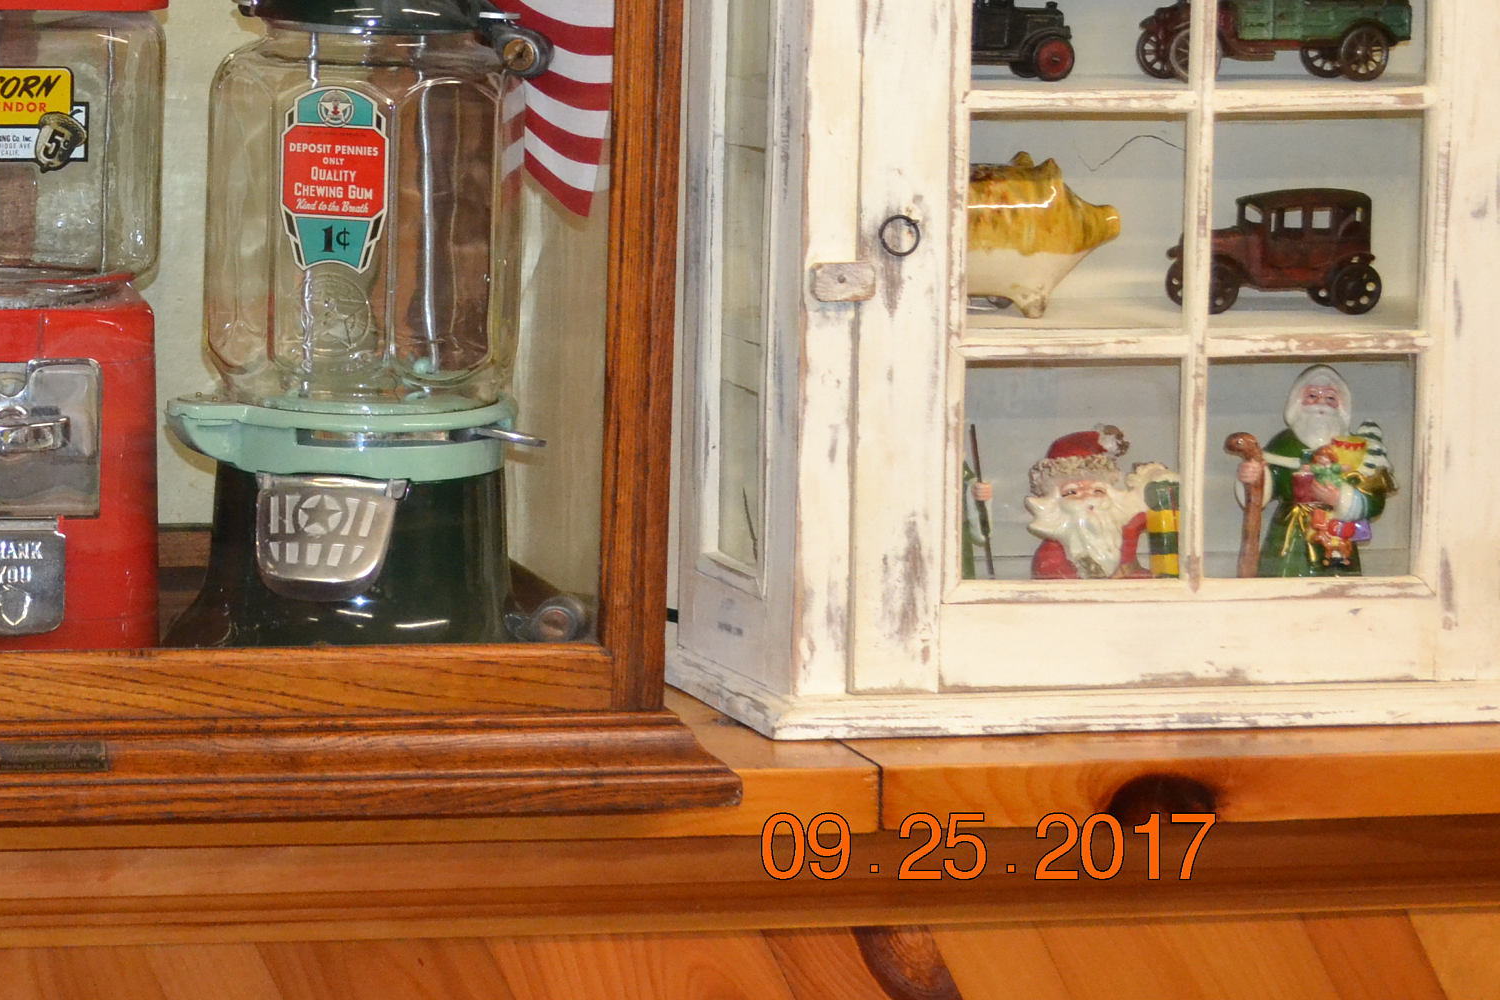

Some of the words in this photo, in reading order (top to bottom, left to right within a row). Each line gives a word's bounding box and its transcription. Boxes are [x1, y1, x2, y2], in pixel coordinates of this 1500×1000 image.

[289, 142, 332, 154] DEPOSIT
[334, 144, 379, 157] PENNIES
[322, 156, 345, 166] ONLY
[310, 165, 357, 182] QUALITY
[294, 182, 344, 199] CHEWING
[347, 184, 373, 200] GUM
[295, 197, 318, 210] Kind
[318, 200, 328, 211] to
[341, 200, 370, 214] Breath
